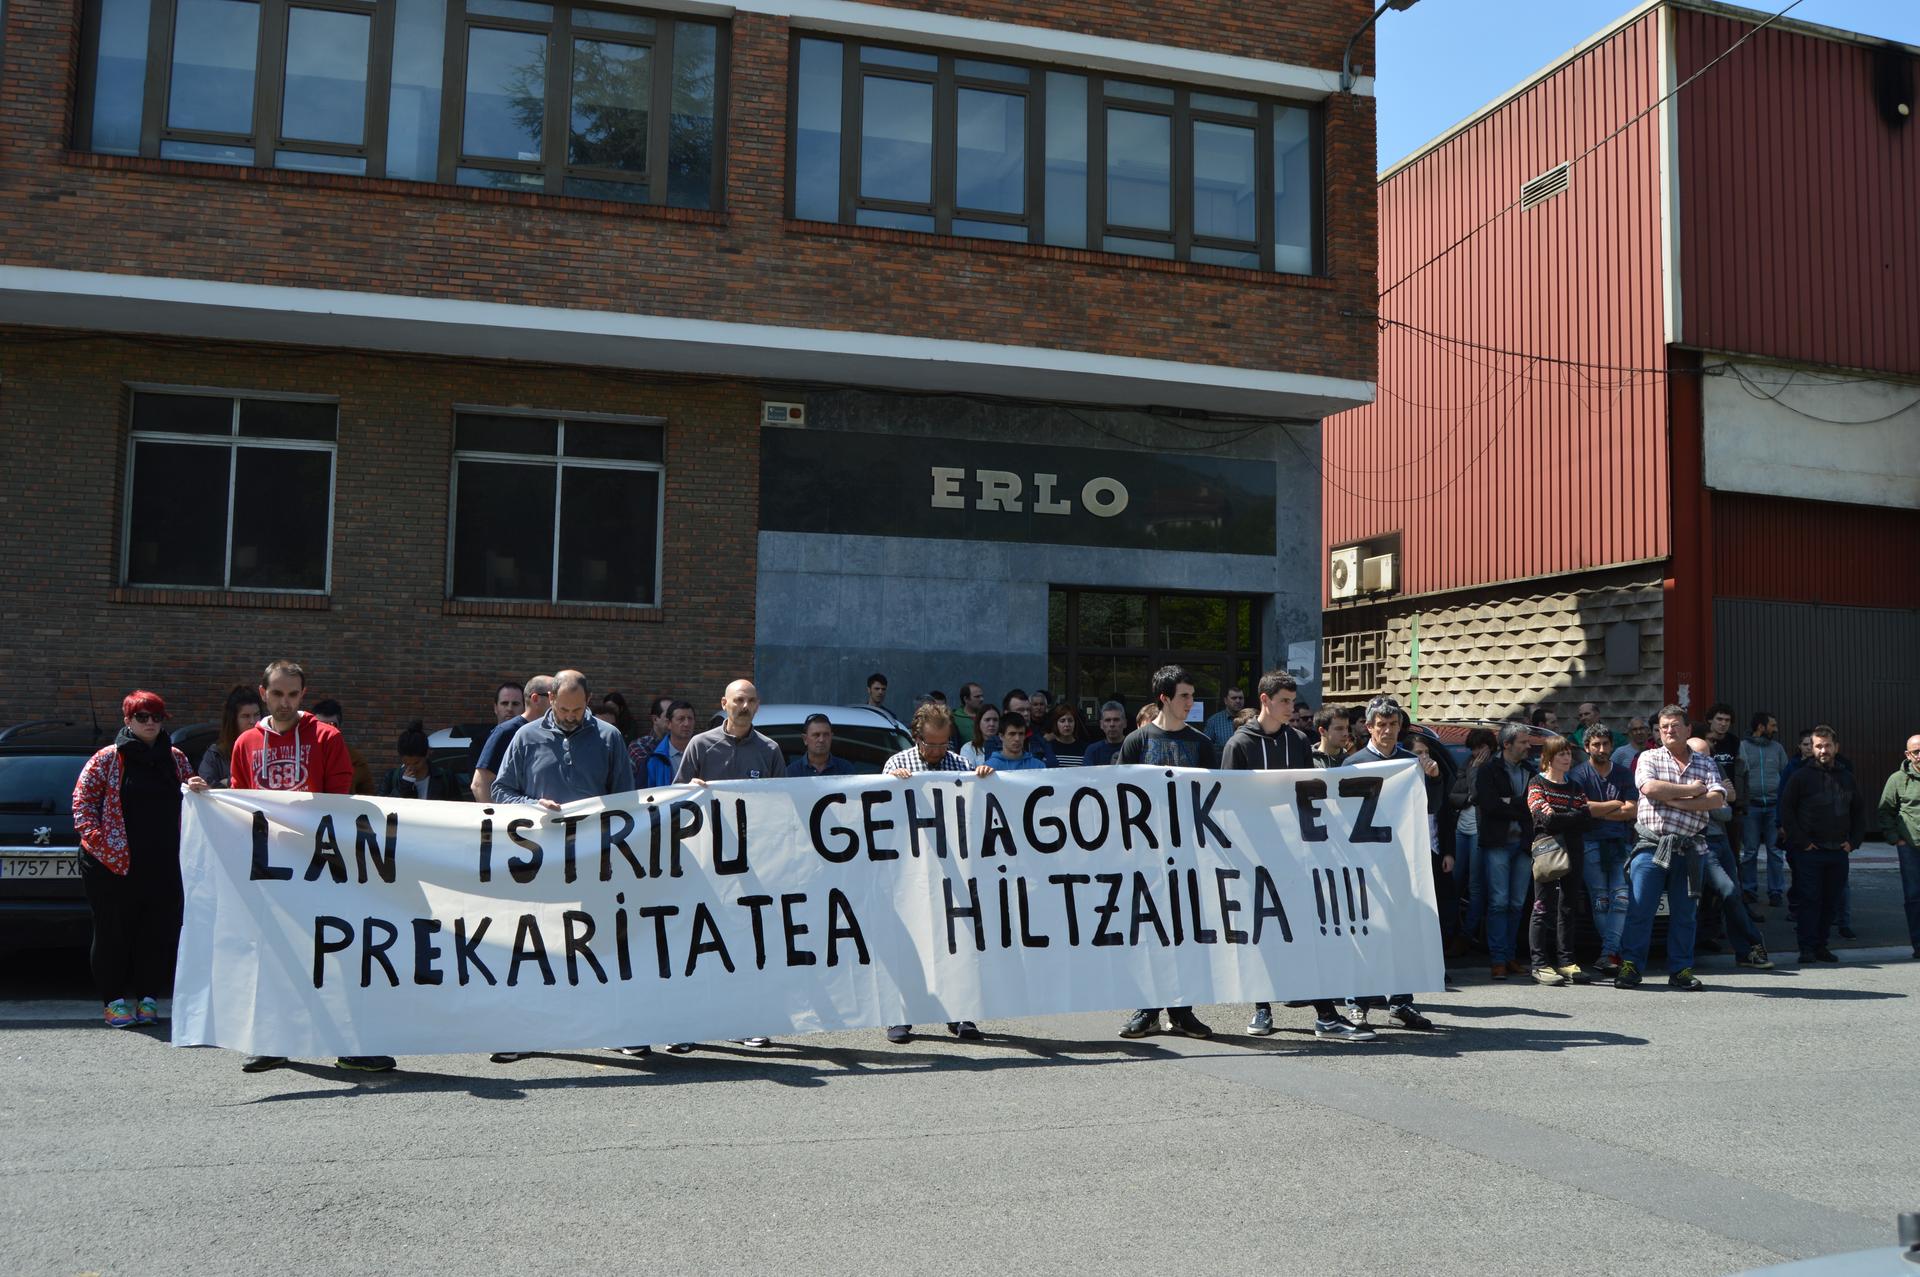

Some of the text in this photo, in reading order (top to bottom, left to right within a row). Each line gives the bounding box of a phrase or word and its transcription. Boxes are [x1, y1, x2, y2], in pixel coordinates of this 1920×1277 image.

[931, 466, 1129, 517] ERLO
[280, 744, 311, 764] VALEY
[249, 810, 399, 885] LAN
[1295, 776, 1393, 844] EZ
[9, 861, 82, 876] 1757 FX
